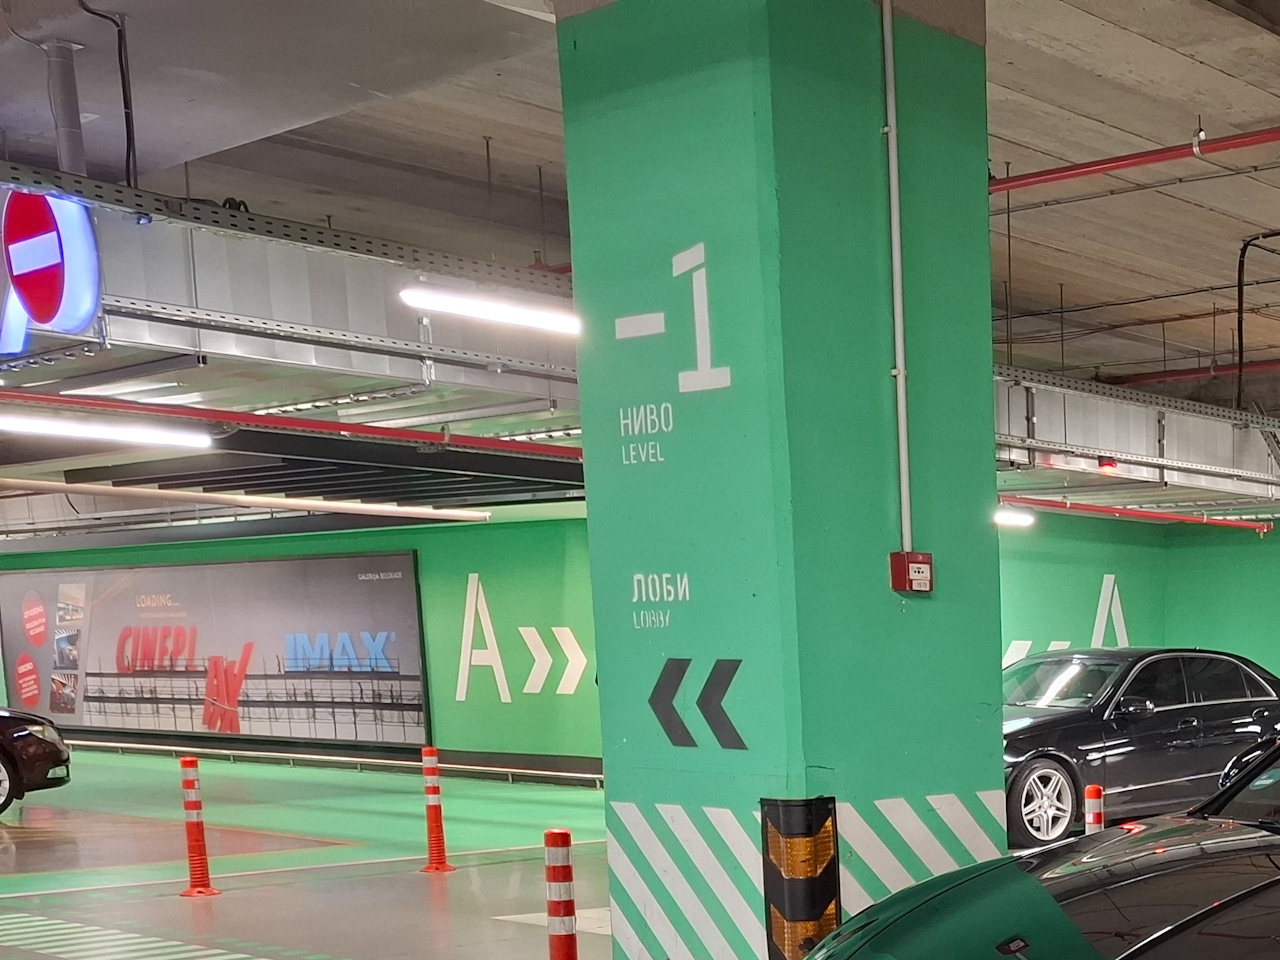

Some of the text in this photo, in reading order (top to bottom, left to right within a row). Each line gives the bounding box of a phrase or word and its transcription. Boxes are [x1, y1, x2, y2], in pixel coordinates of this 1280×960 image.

[615, 242, 732, 393] -1
[620, 402, 673, 436] НИВО
[621, 441, 665, 464] LEVEL
[632, 572, 690, 603] ЛОБИ
[633, 609, 671, 628] LOBBY
[456, 573, 512, 703] A
